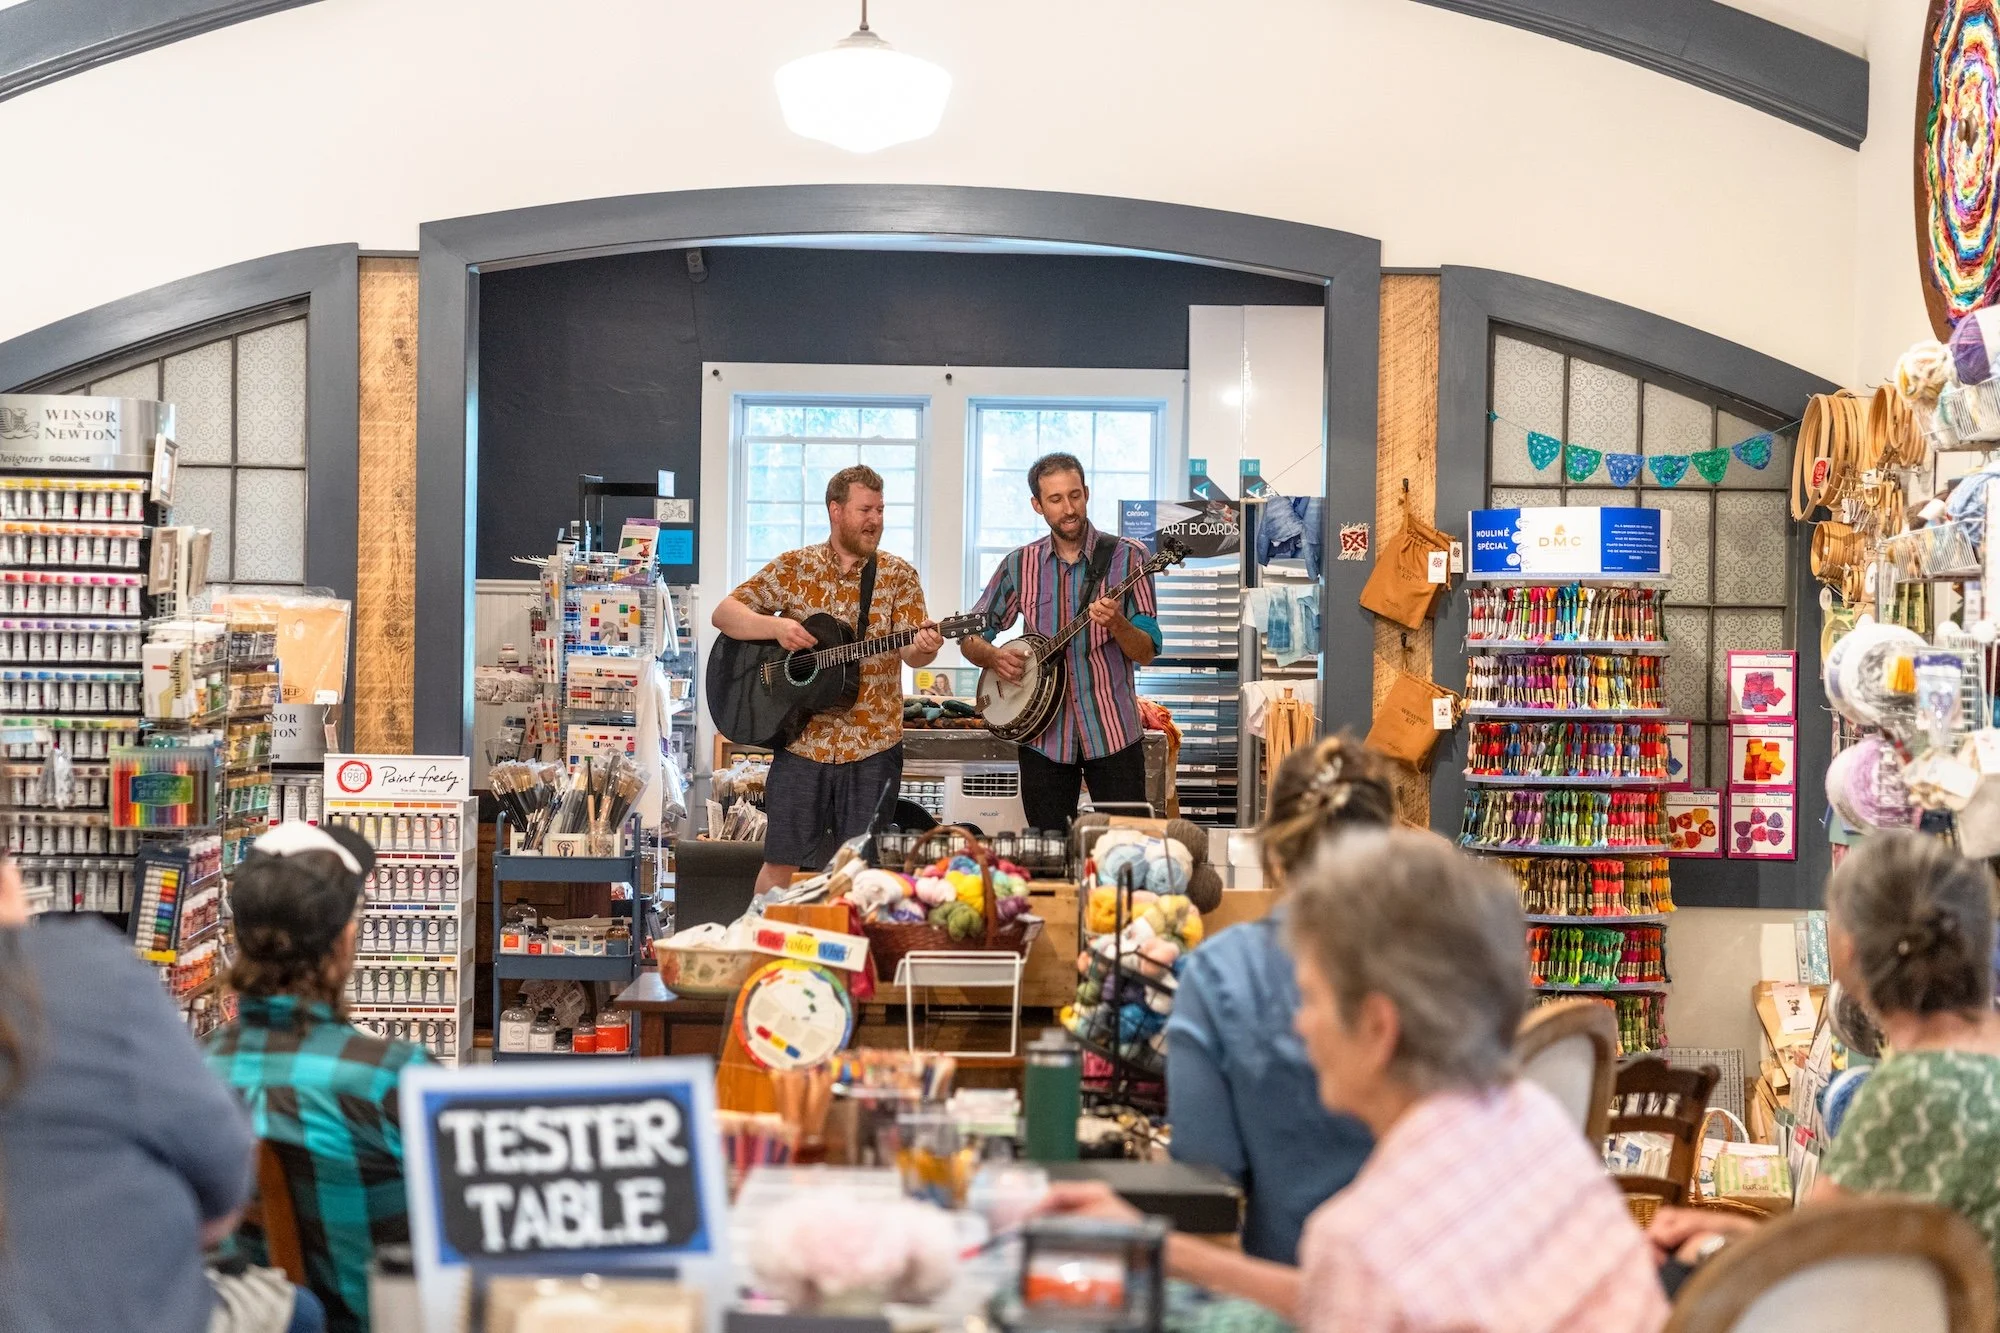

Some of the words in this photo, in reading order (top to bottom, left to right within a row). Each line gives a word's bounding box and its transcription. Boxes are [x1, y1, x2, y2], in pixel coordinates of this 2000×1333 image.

[45, 409, 117, 423] WINSOR
[77, 420, 85, 428] &
[45, 427, 117, 441] NEWTON
[49, 455, 91, 463] GOUACHE
[1162, 523, 1187, 535] ART
[1189, 523, 1239, 535] BOARDS
[1476, 527, 1510, 538] MOULINÉ
[1477, 541, 1508, 551] SPÉCIAL
[1401, 573, 1413, 582] KIT
[264, 713, 297, 723] NSOR
[1401, 707, 1428, 726] WEAVING
[1405, 717, 1416, 726] KIT
[273, 728, 297, 738] TON
[343, 771, 366, 783] 1980
[380, 765, 416, 786] Paint
[418, 765, 463, 793] freely.
[1700, 795, 1710, 803] Kit
[438, 1098, 689, 1176] TESTER
[463, 1177, 669, 1253] TABLE
